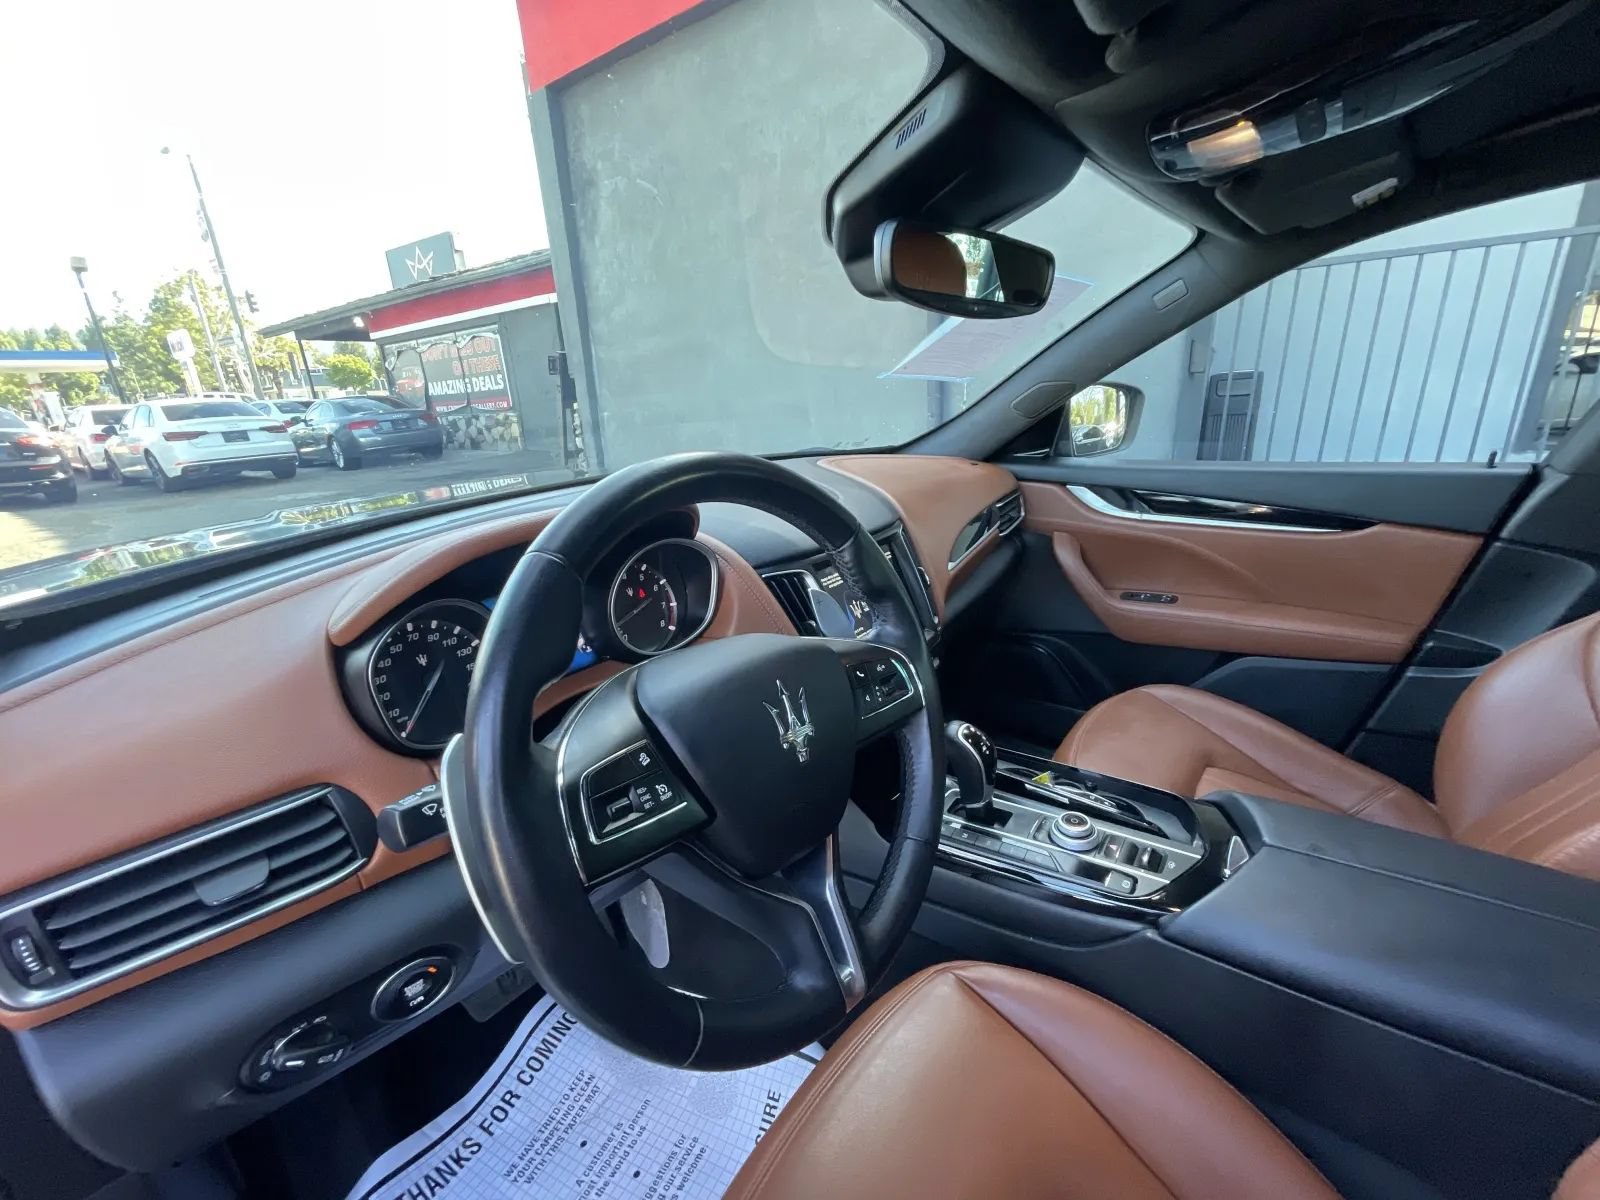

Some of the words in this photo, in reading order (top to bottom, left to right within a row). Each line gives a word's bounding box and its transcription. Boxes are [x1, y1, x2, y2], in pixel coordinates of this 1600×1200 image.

[428, 378, 472, 397] AMAZING
[472, 374, 504, 393] DEALS
[389, 643, 403, 654] 50
[407, 632, 419, 642] 70
[427, 632, 440, 642] 90
[442, 636, 457, 647] 110
[456, 646, 472, 657] 130
[377, 658, 392, 668] 40
[388, 708, 400, 718] 10
[479, 1089, 522, 1138] FOR
[503, 1161, 520, 1178] WE
[518, 1135, 541, 1161] HAVE
[538, 1107, 561, 1135] TRIED
[559, 1093, 571, 1106] TO
[569, 1069, 586, 1093] KEEP
[511, 1156, 537, 1184] YOUR
[534, 1103, 576, 1157] CARPETING
[573, 1074, 597, 1104] CLEAN
[523, 1158, 548, 1185] WITH
[545, 1135, 567, 1158] THIS
[564, 1104, 588, 1136] PAPER
[584, 1083, 601, 1105] MAT
[575, 1178, 586, 1188] A
[583, 1131, 617, 1178] customer
[614, 1121, 625, 1132] is
[595, 1130, 631, 1180] important
[628, 1097, 651, 1132] person
[594, 1180, 611, 1198] the
[608, 1149, 631, 1179] world
[627, 1139, 638, 1150] to
[641, 1149, 678, 1200] ggestions
[673, 1133, 688, 1149] for
[662, 1172, 677, 1193] our
[674, 1136, 700, 1173] service
[676, 1144, 709, 1192] welcome.
